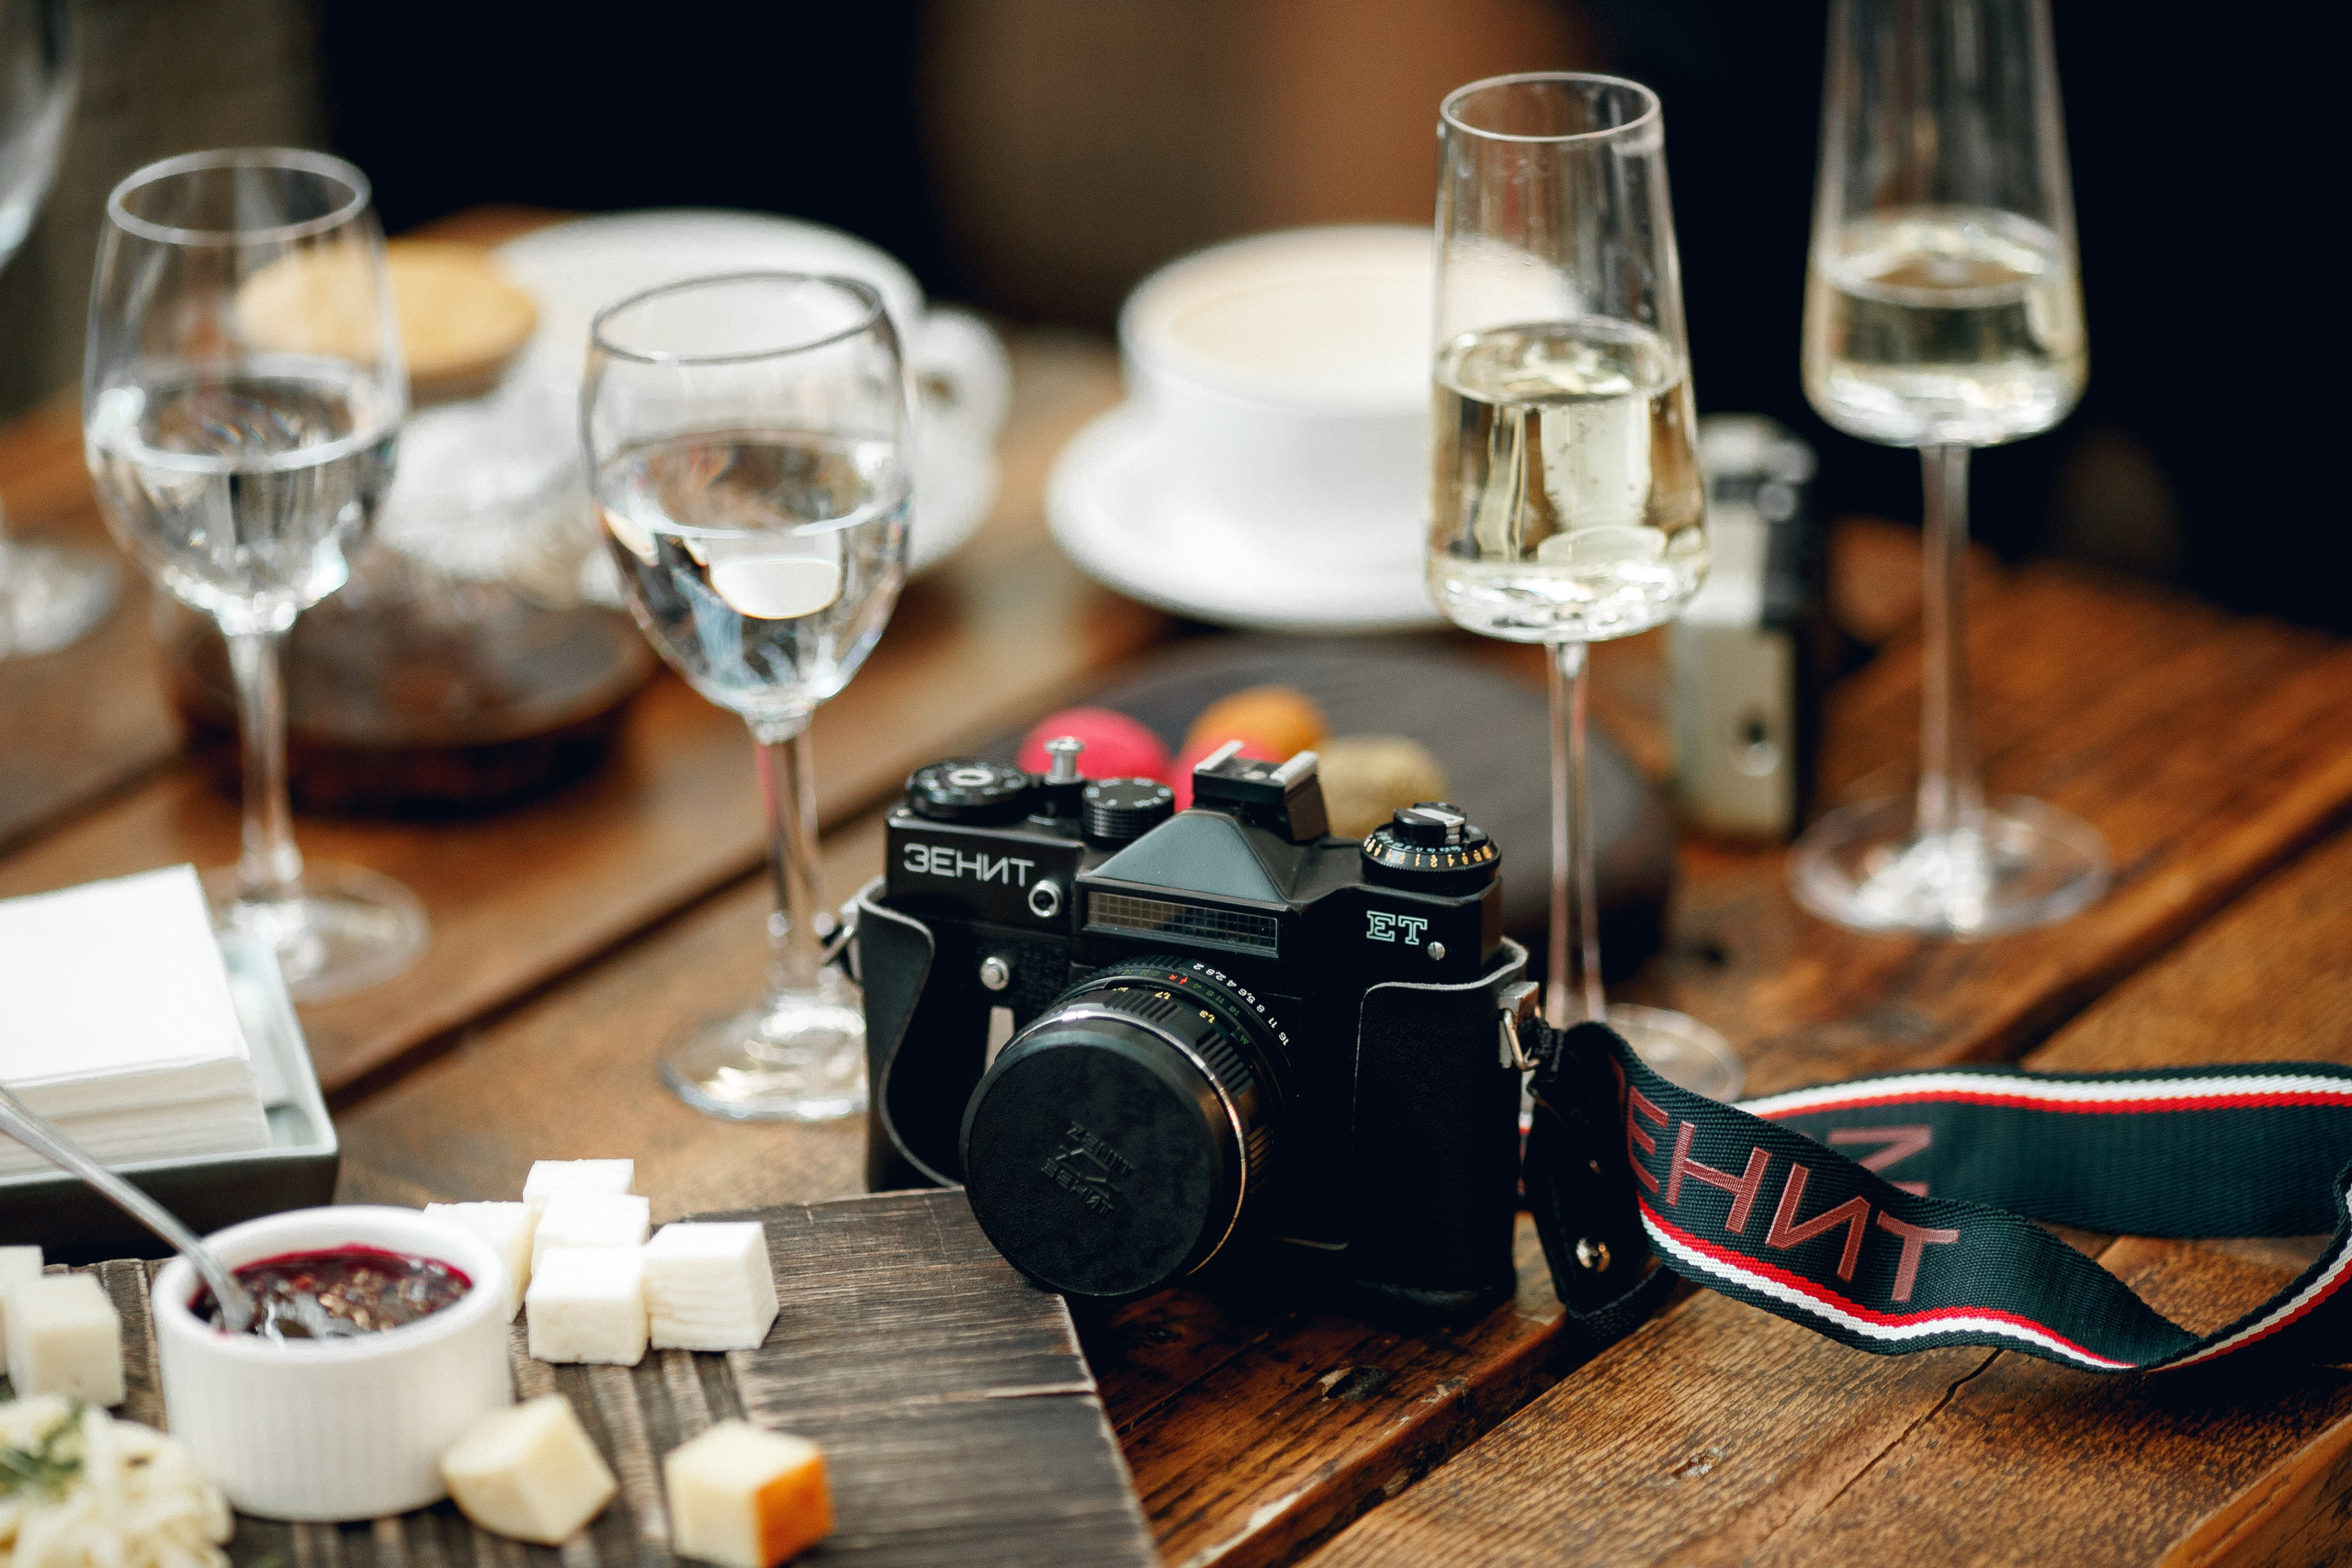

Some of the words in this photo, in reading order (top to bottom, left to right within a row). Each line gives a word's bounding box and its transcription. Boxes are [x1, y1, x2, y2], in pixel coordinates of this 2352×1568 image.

[903, 842, 1035, 887] ЗЕНИТ
[1366, 909, 1428, 945] ET
[1205, 968, 1227, 981] 2,8
[1227, 979, 1237, 987] 4
[1238, 987, 1256, 1004] 5,6
[1256, 1004, 1265, 1013] 8
[1268, 1017, 1278, 1029] 11
[1278, 1032, 1289, 1046] 16
[1610, 1059, 1961, 1302] ЕНИТ
